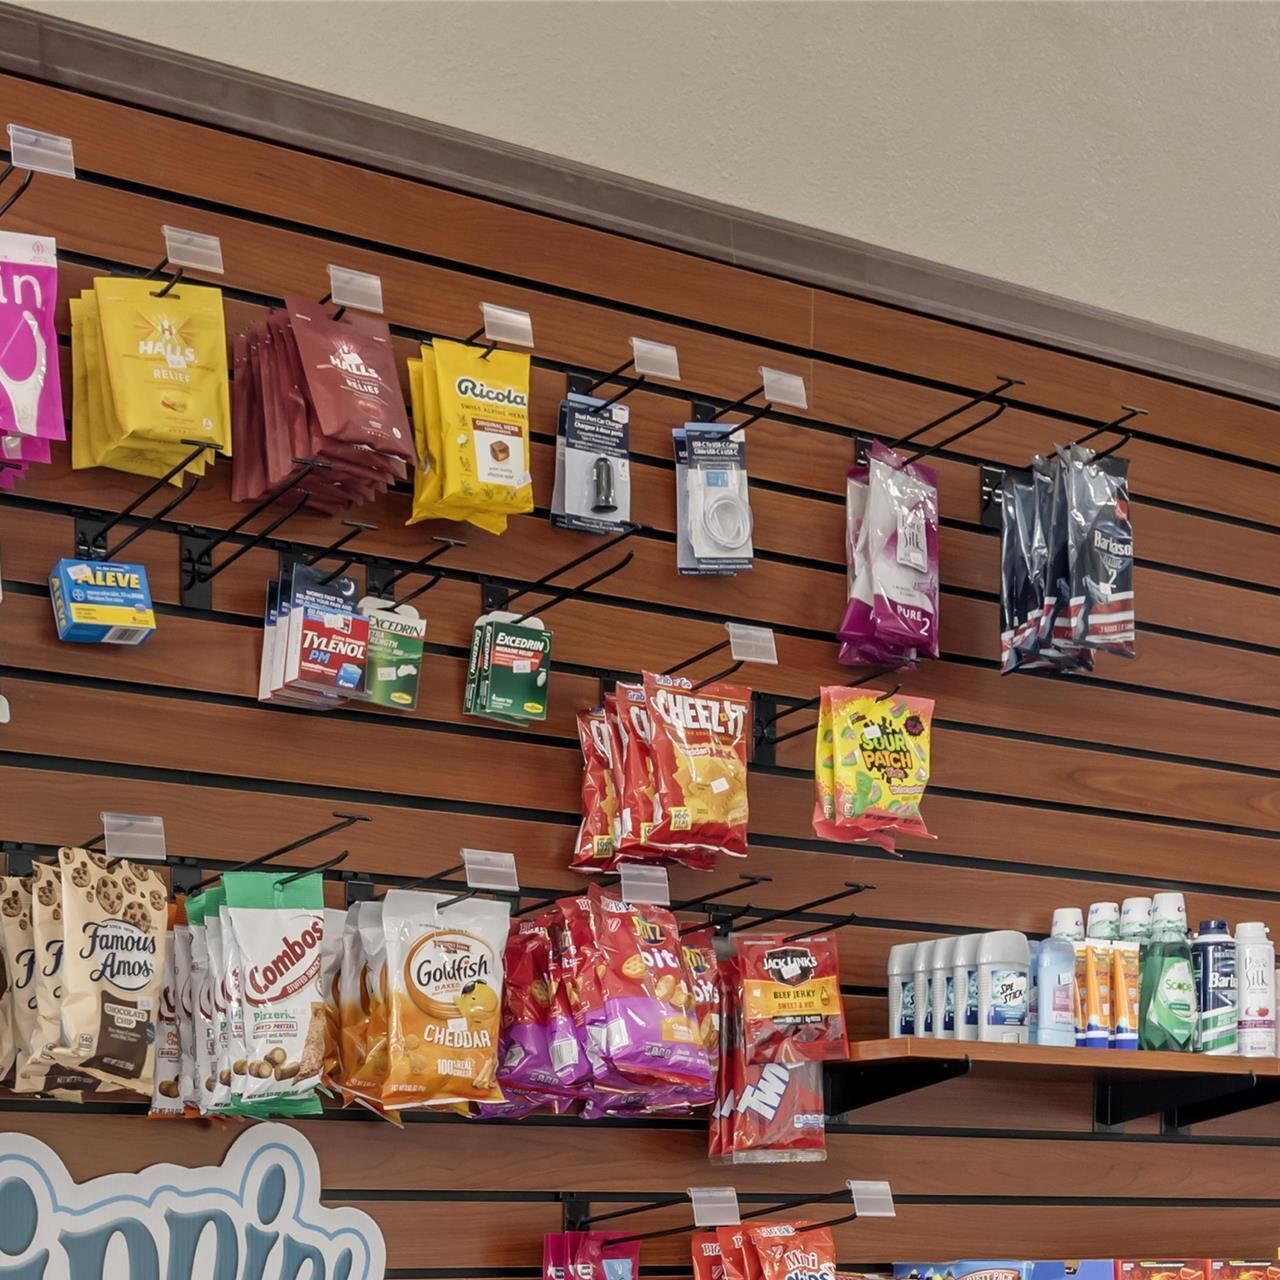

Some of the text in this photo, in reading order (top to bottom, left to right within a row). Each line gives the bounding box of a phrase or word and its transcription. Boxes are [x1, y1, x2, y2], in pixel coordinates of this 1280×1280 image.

[138, 340, 195, 362] HALLS
[152, 369, 192, 384] RELIEF
[329, 355, 380, 379] HALLS
[346, 379, 380, 396] RELIEF
[456, 378, 526, 407] Ricola
[76, 571, 140, 589] ALEVE
[896, 605, 923, 622] PURE
[368, 615, 423, 637] EXCEDRIN
[919, 618, 930, 637] 2
[303, 630, 367, 660] TYLENOL
[483, 625, 493, 670] EXCEDRIN
[496, 632, 545, 651] EXCEDRIN
[308, 650, 331, 664] PM
[470, 629, 482, 674] EXCEDRIN
[861, 734, 909, 752] SOUR
[863, 751, 913, 769] PATCH
[79, 920, 157, 960] Famous
[89, 951, 155, 983] Amos
[248, 920, 324, 995] Combos
[763, 957, 786, 971] JACK
[1244, 951, 1268, 970] Pure
[417, 954, 489, 988] Goldfish
[1245, 970, 1270, 991] Silk
[773, 990, 816, 999] BEEF JERKY
[1002, 989, 1024, 1005] STICK
[105, 1003, 146, 1021] CHOCOLATE
[116, 1016, 135, 1026] CHIP
[272, 1022, 295, 1030] PRETZEL
[423, 1024, 492, 1048] CHEDDAR
[785, 1249, 818, 1270] Mini
